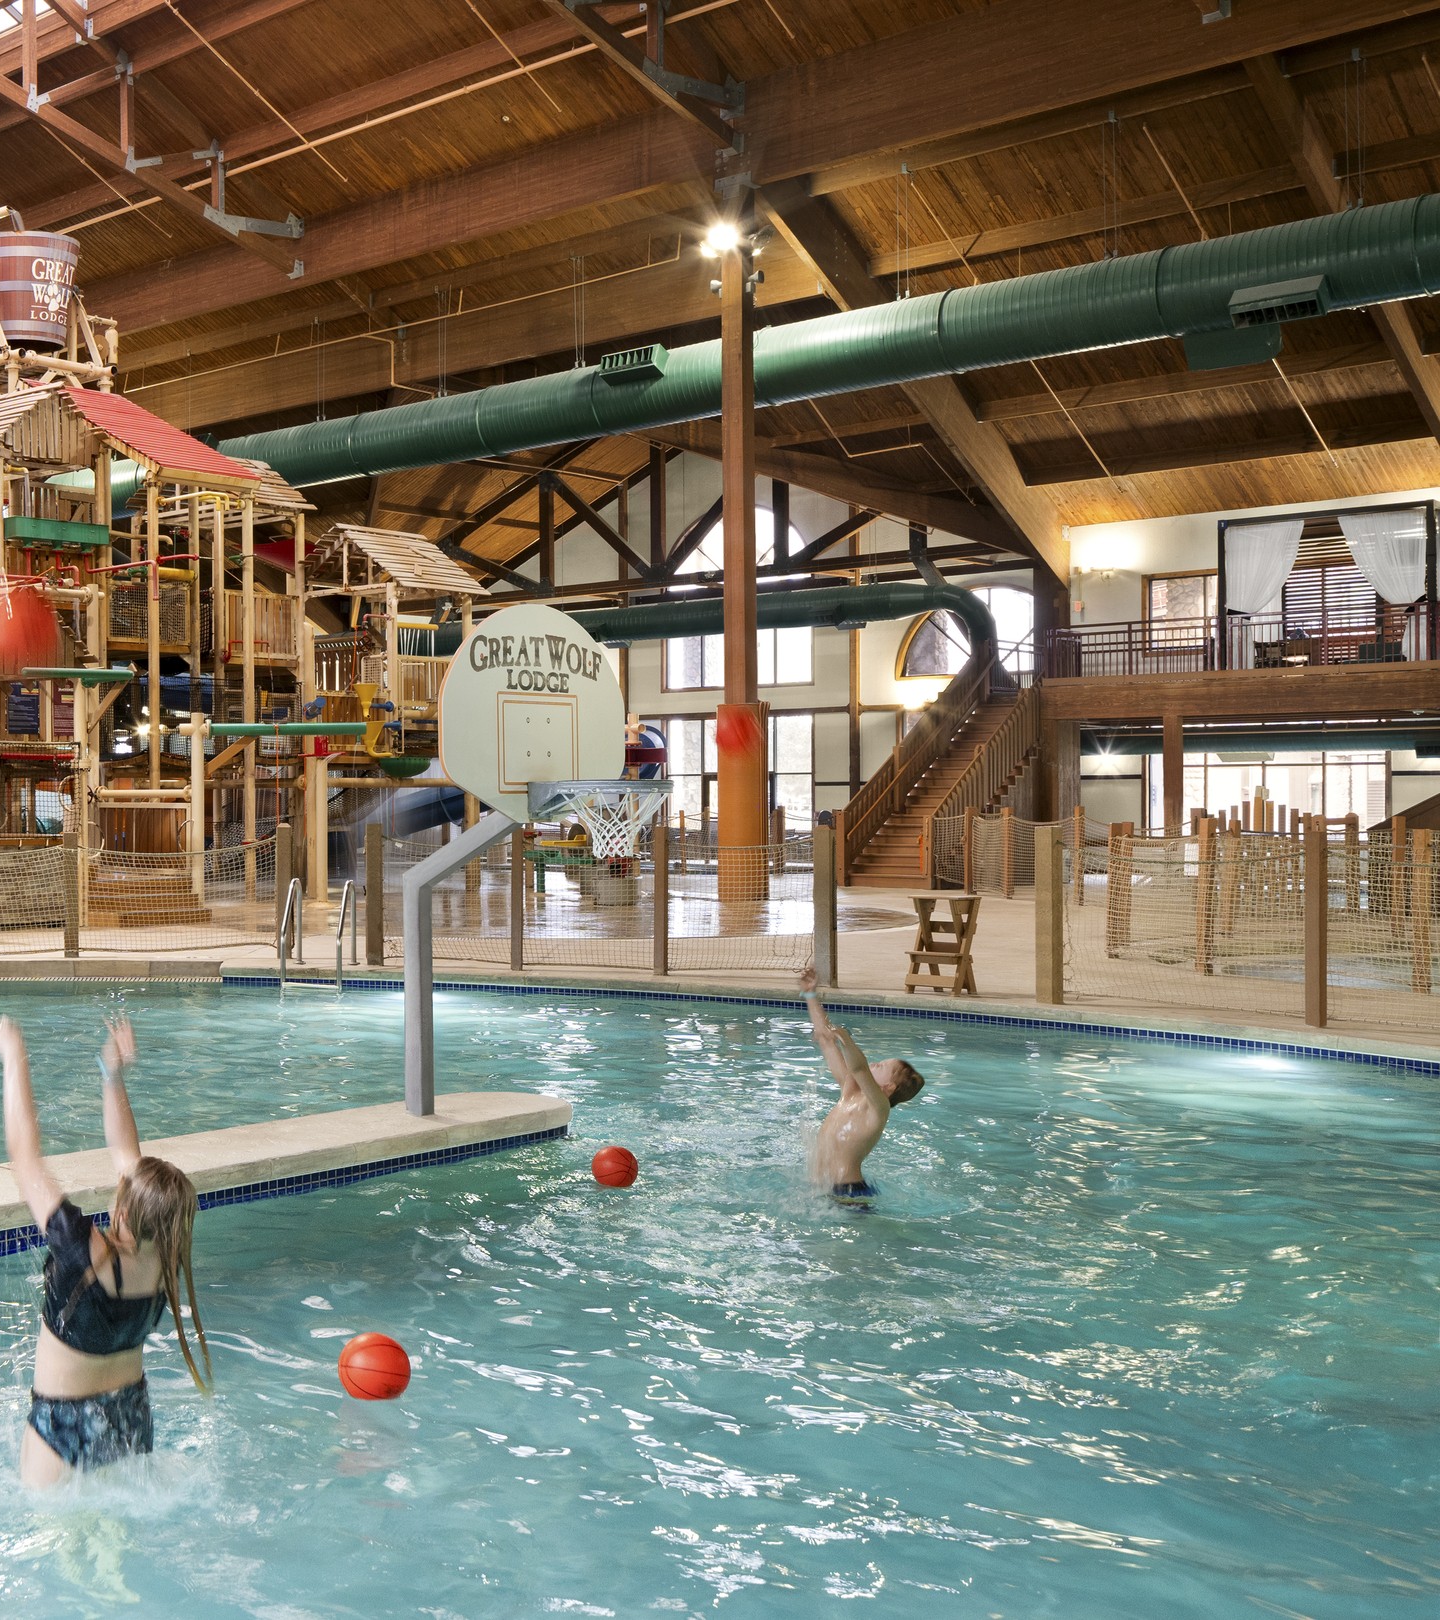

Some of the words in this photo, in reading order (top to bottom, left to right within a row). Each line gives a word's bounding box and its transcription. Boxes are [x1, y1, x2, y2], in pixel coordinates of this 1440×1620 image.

[31, 258, 75, 286] GREAT
[30, 310, 67, 325] LODGE
[470, 634, 544, 672] GREAT
[545, 634, 602, 681] WOLF
[506, 669, 570, 693] LODGE
